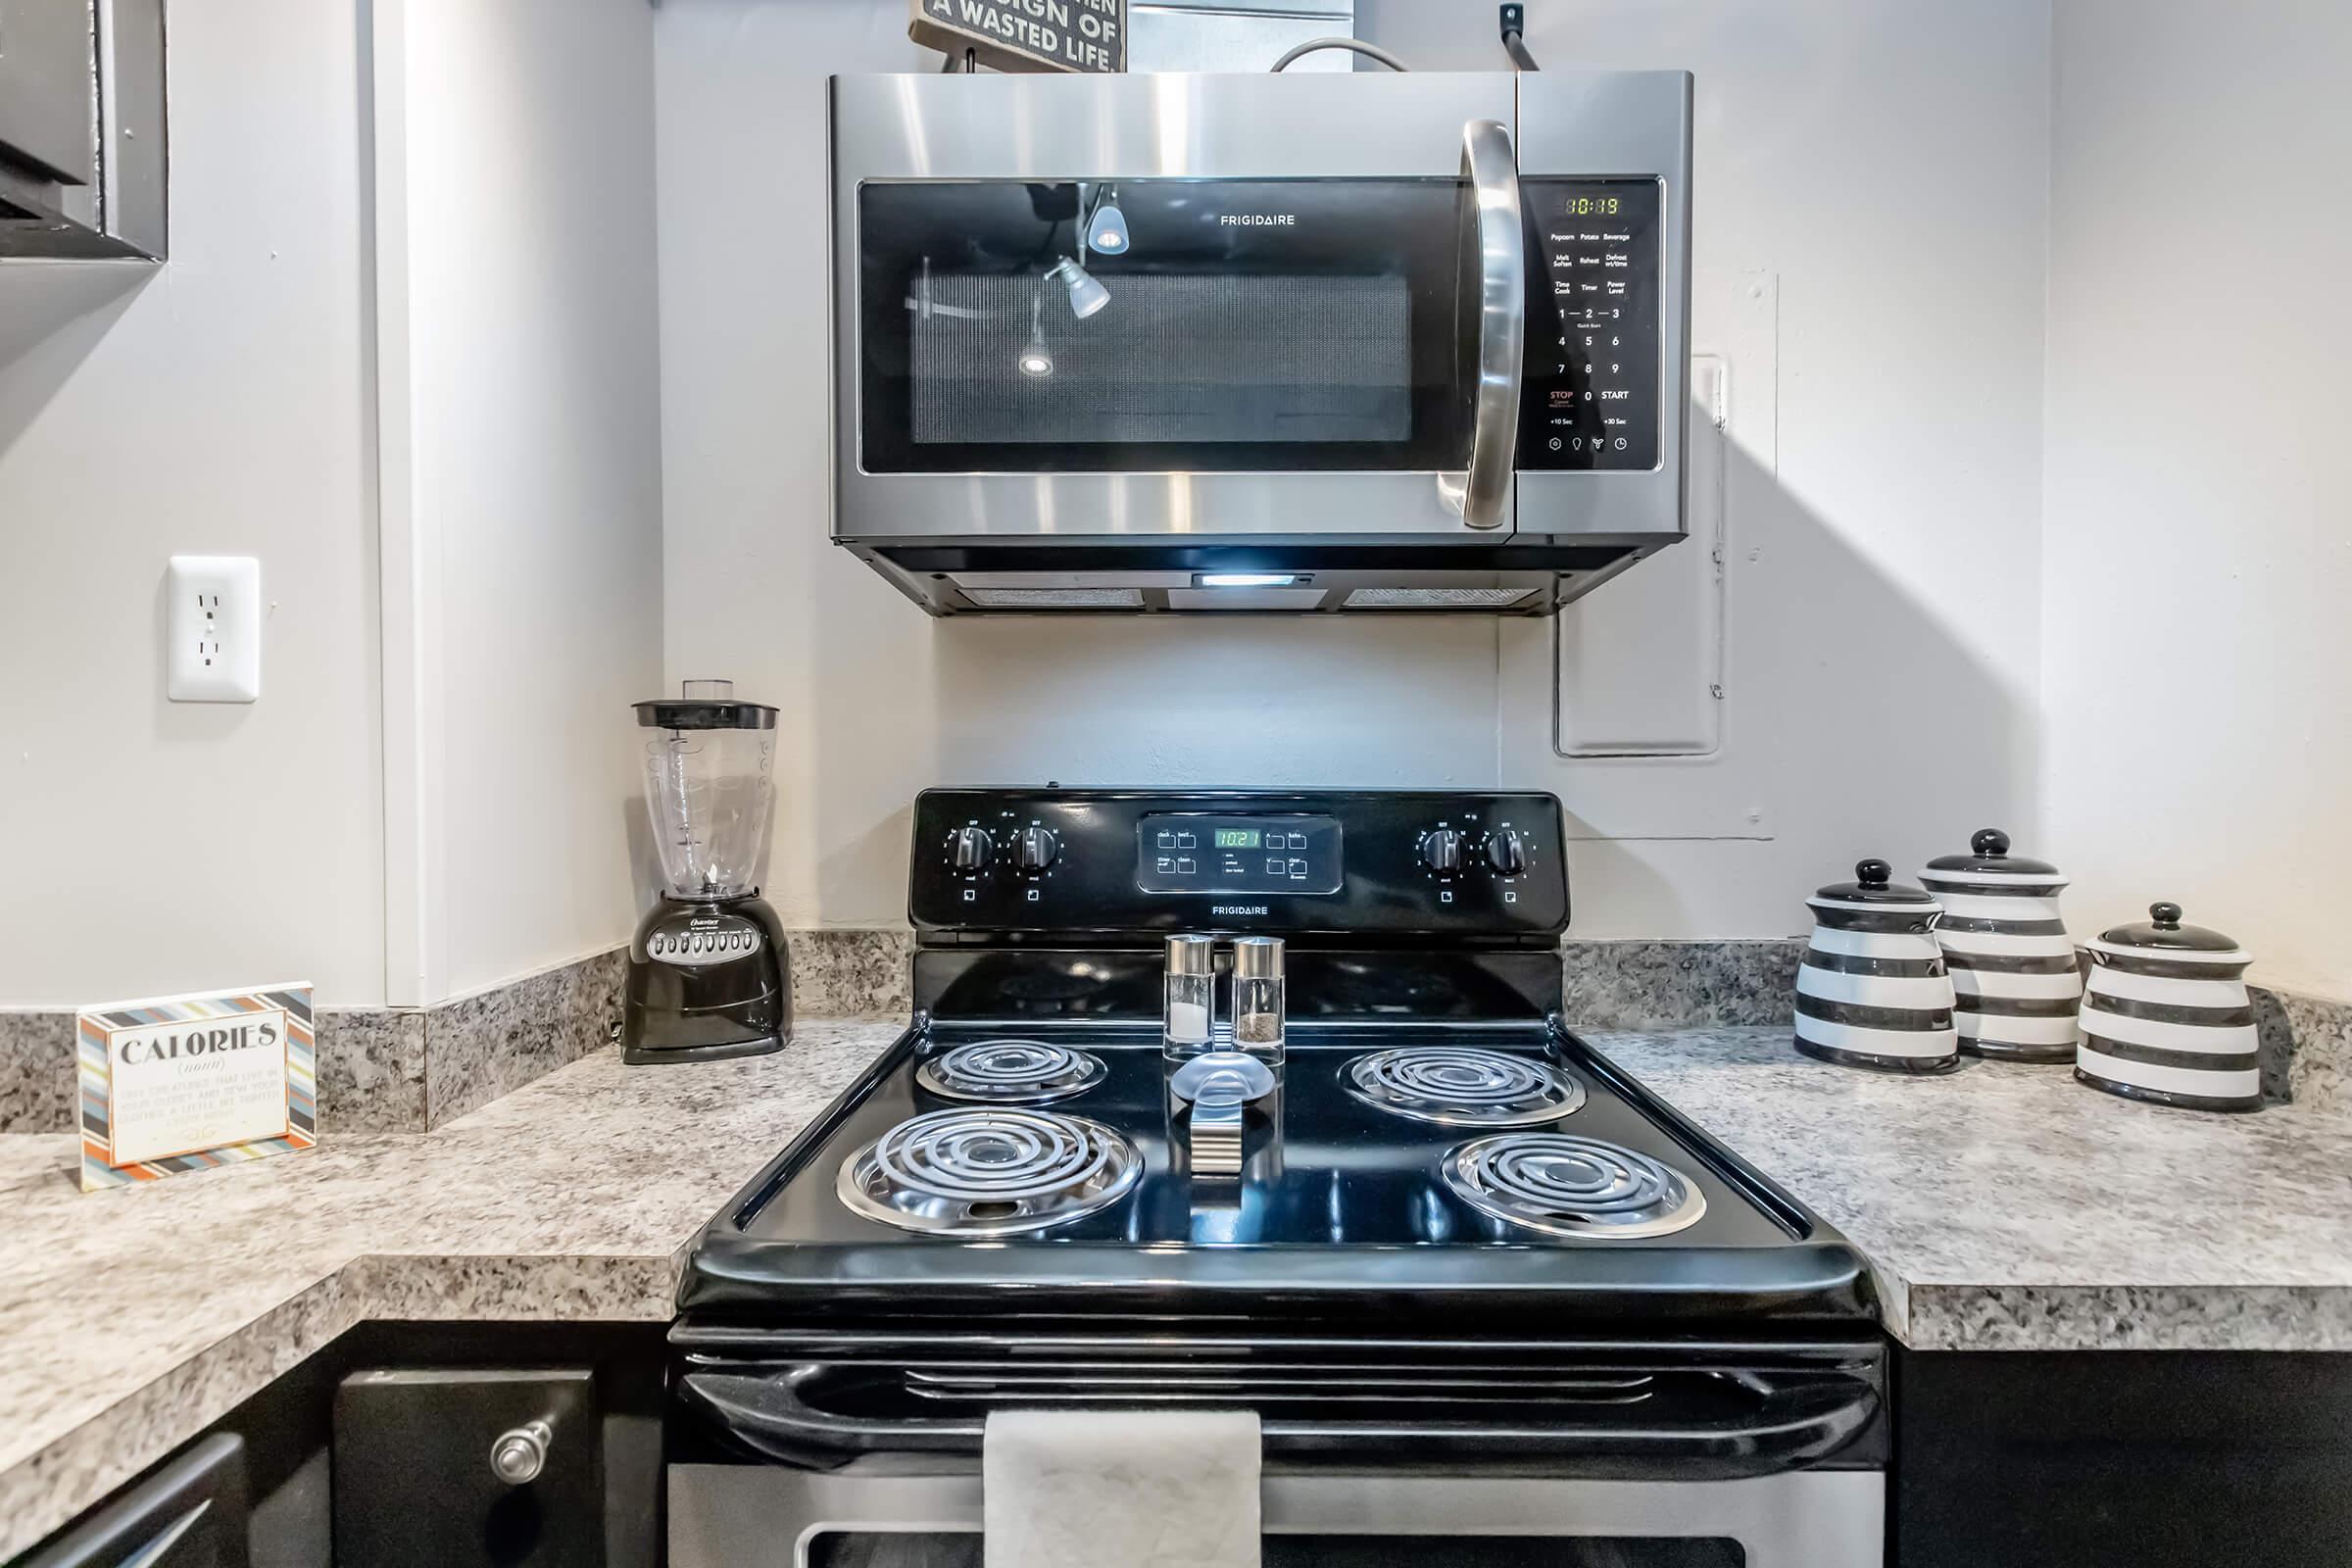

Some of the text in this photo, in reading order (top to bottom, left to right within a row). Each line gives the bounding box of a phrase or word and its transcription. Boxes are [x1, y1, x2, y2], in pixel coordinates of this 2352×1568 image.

[933, 0, 952, 17] A
[959, 0, 1058, 52] WASTED
[1079, 14, 1116, 43] OF
[1569, 198, 1618, 215] 10:19
[1220, 215, 1295, 225] FRIGIDAIRE
[1550, 233, 1575, 242] Popcorn
[1602, 233, 1631, 242] Beverage
[1559, 309, 1565, 318] 1
[1586, 308, 1592, 318] 2
[1612, 308, 1620, 318] 3
[1558, 336, 1566, 346] 4
[1586, 336, 1592, 346] 5
[1612, 336, 1620, 346] 6
[1558, 364, 1565, 373] 7
[1585, 364, 1592, 373] 8
[1611, 364, 1620, 373] 9
[1585, 391, 1592, 401] 0
[1601, 391, 1630, 400] START
[1212, 906, 1268, 915] FRIGIDAIRE
[120, 1022, 278, 1065] CALORIES
[177, 1058, 226, 1074] (noun)
